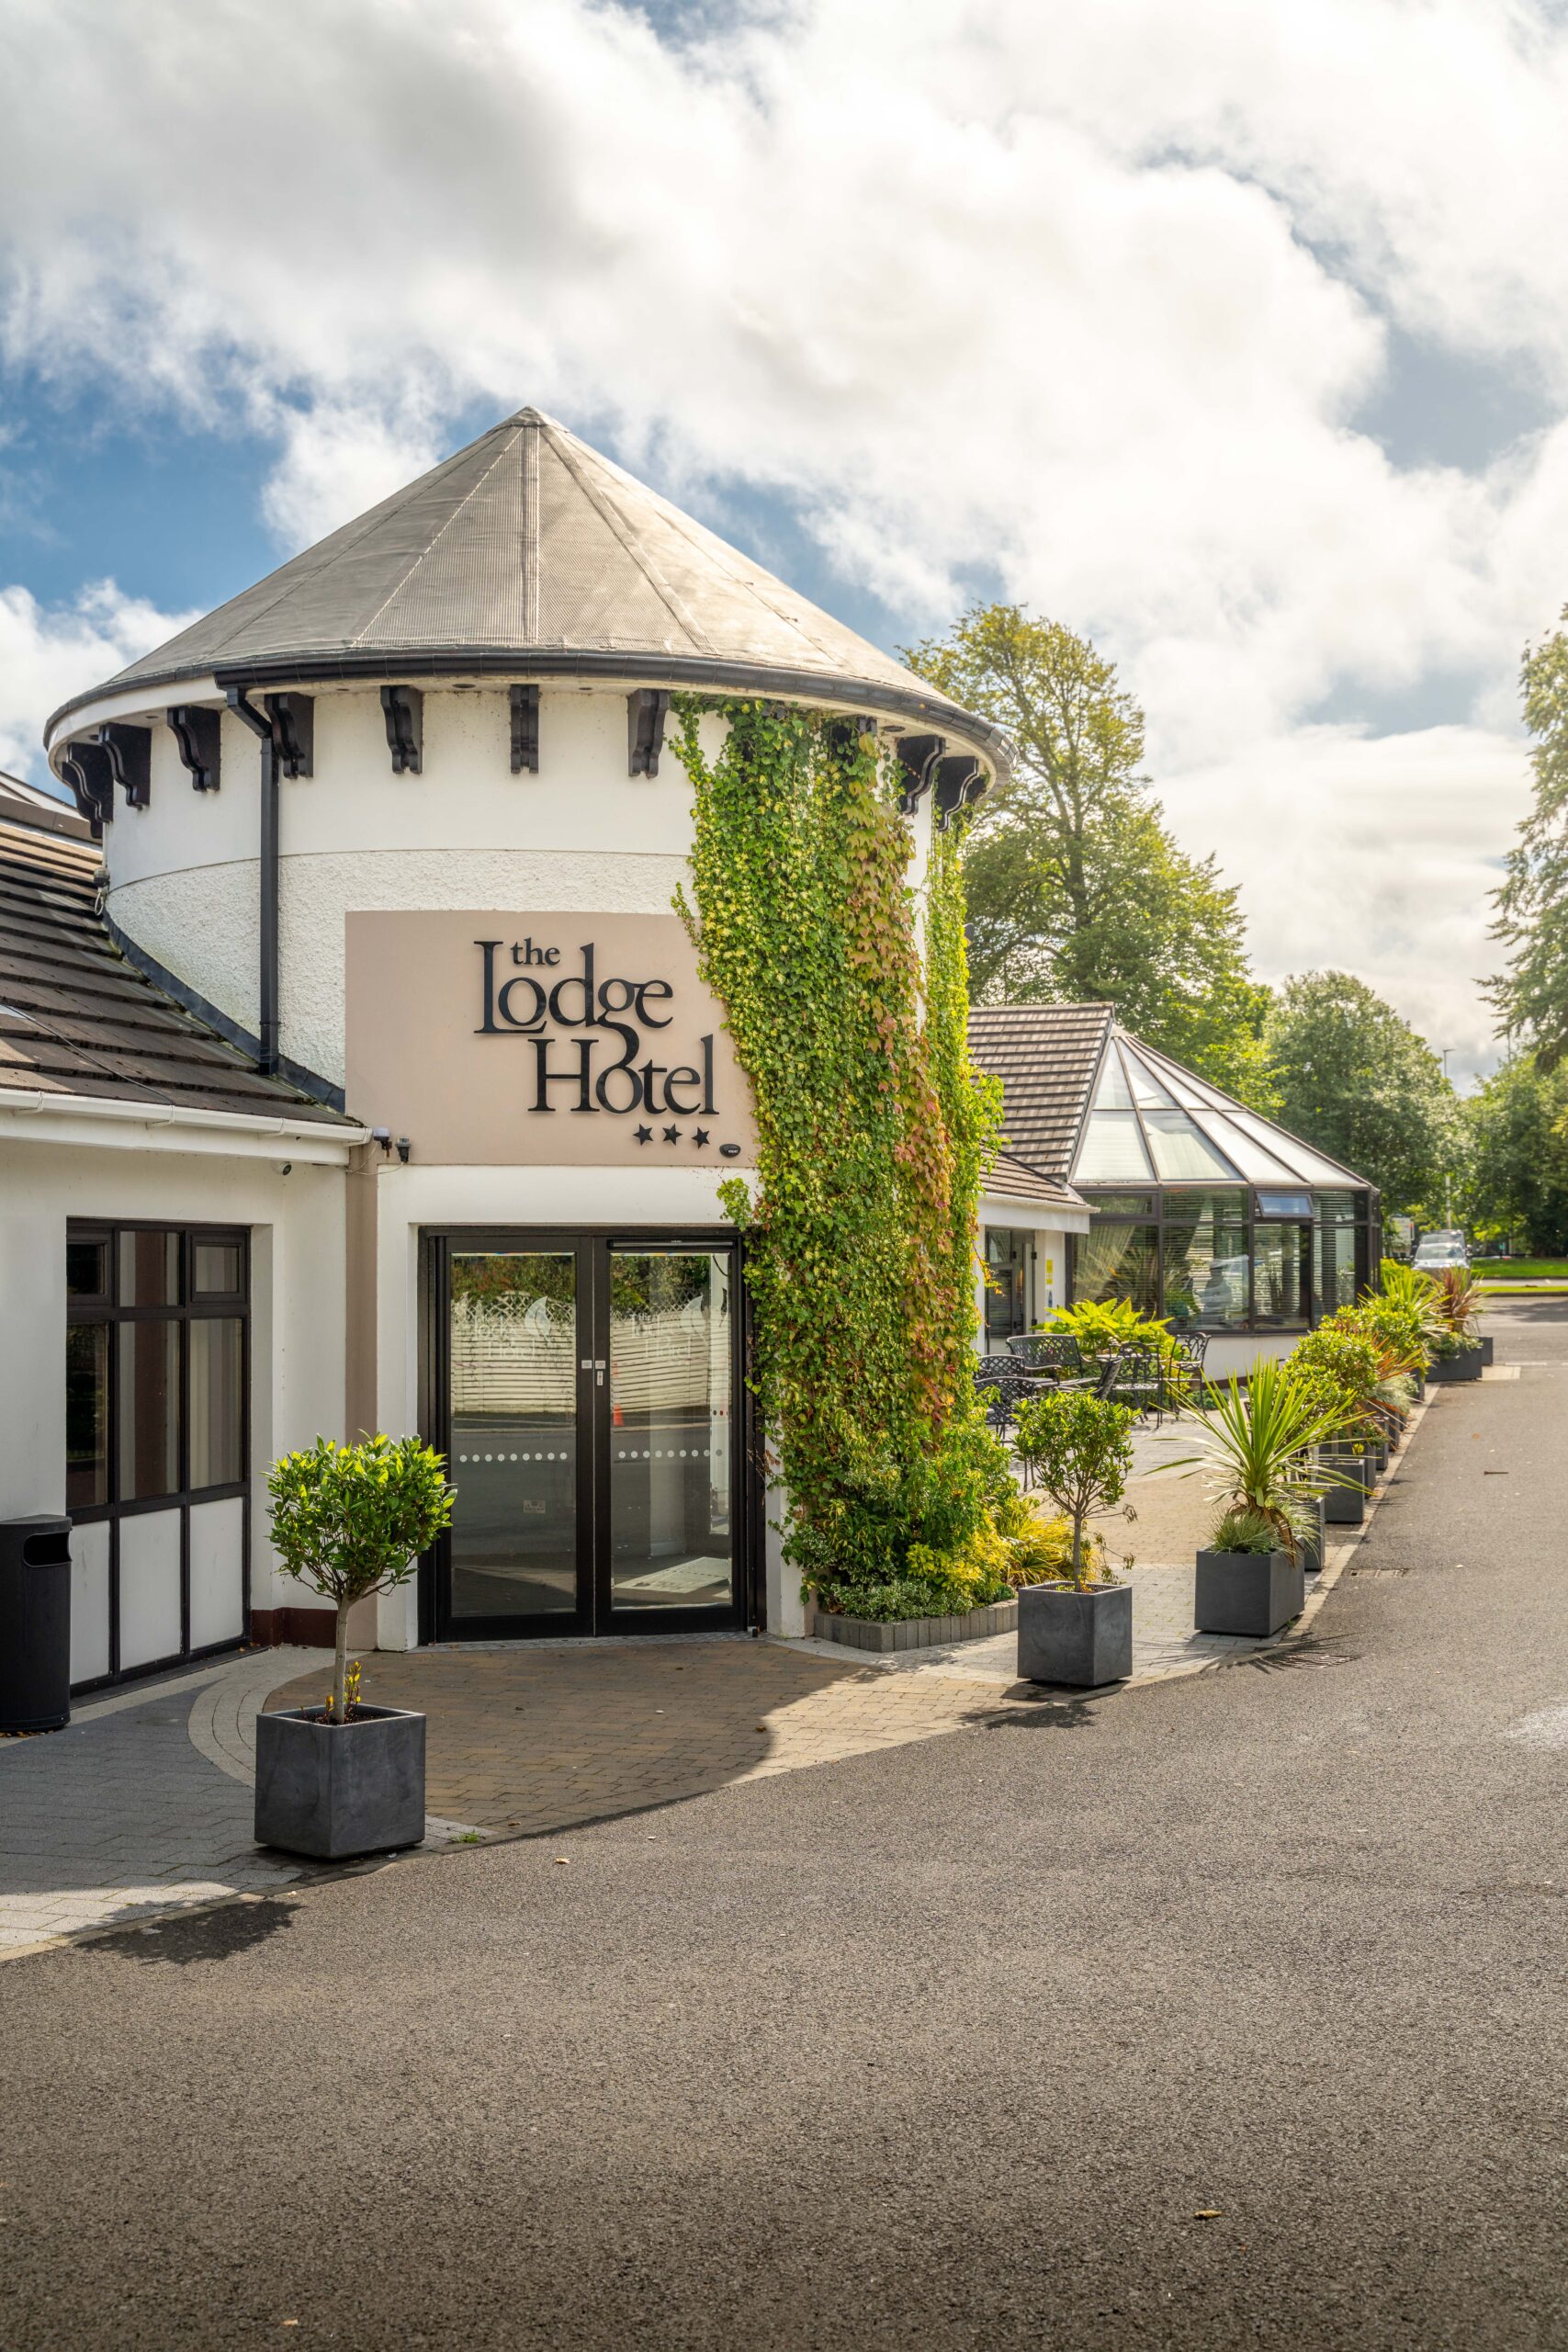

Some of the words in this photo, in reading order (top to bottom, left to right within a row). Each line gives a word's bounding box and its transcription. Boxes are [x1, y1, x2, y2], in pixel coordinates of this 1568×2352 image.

[510, 937, 560, 966] the
[474, 941, 673, 1066] Lodge
[527, 1034, 720, 1115] Hotel
